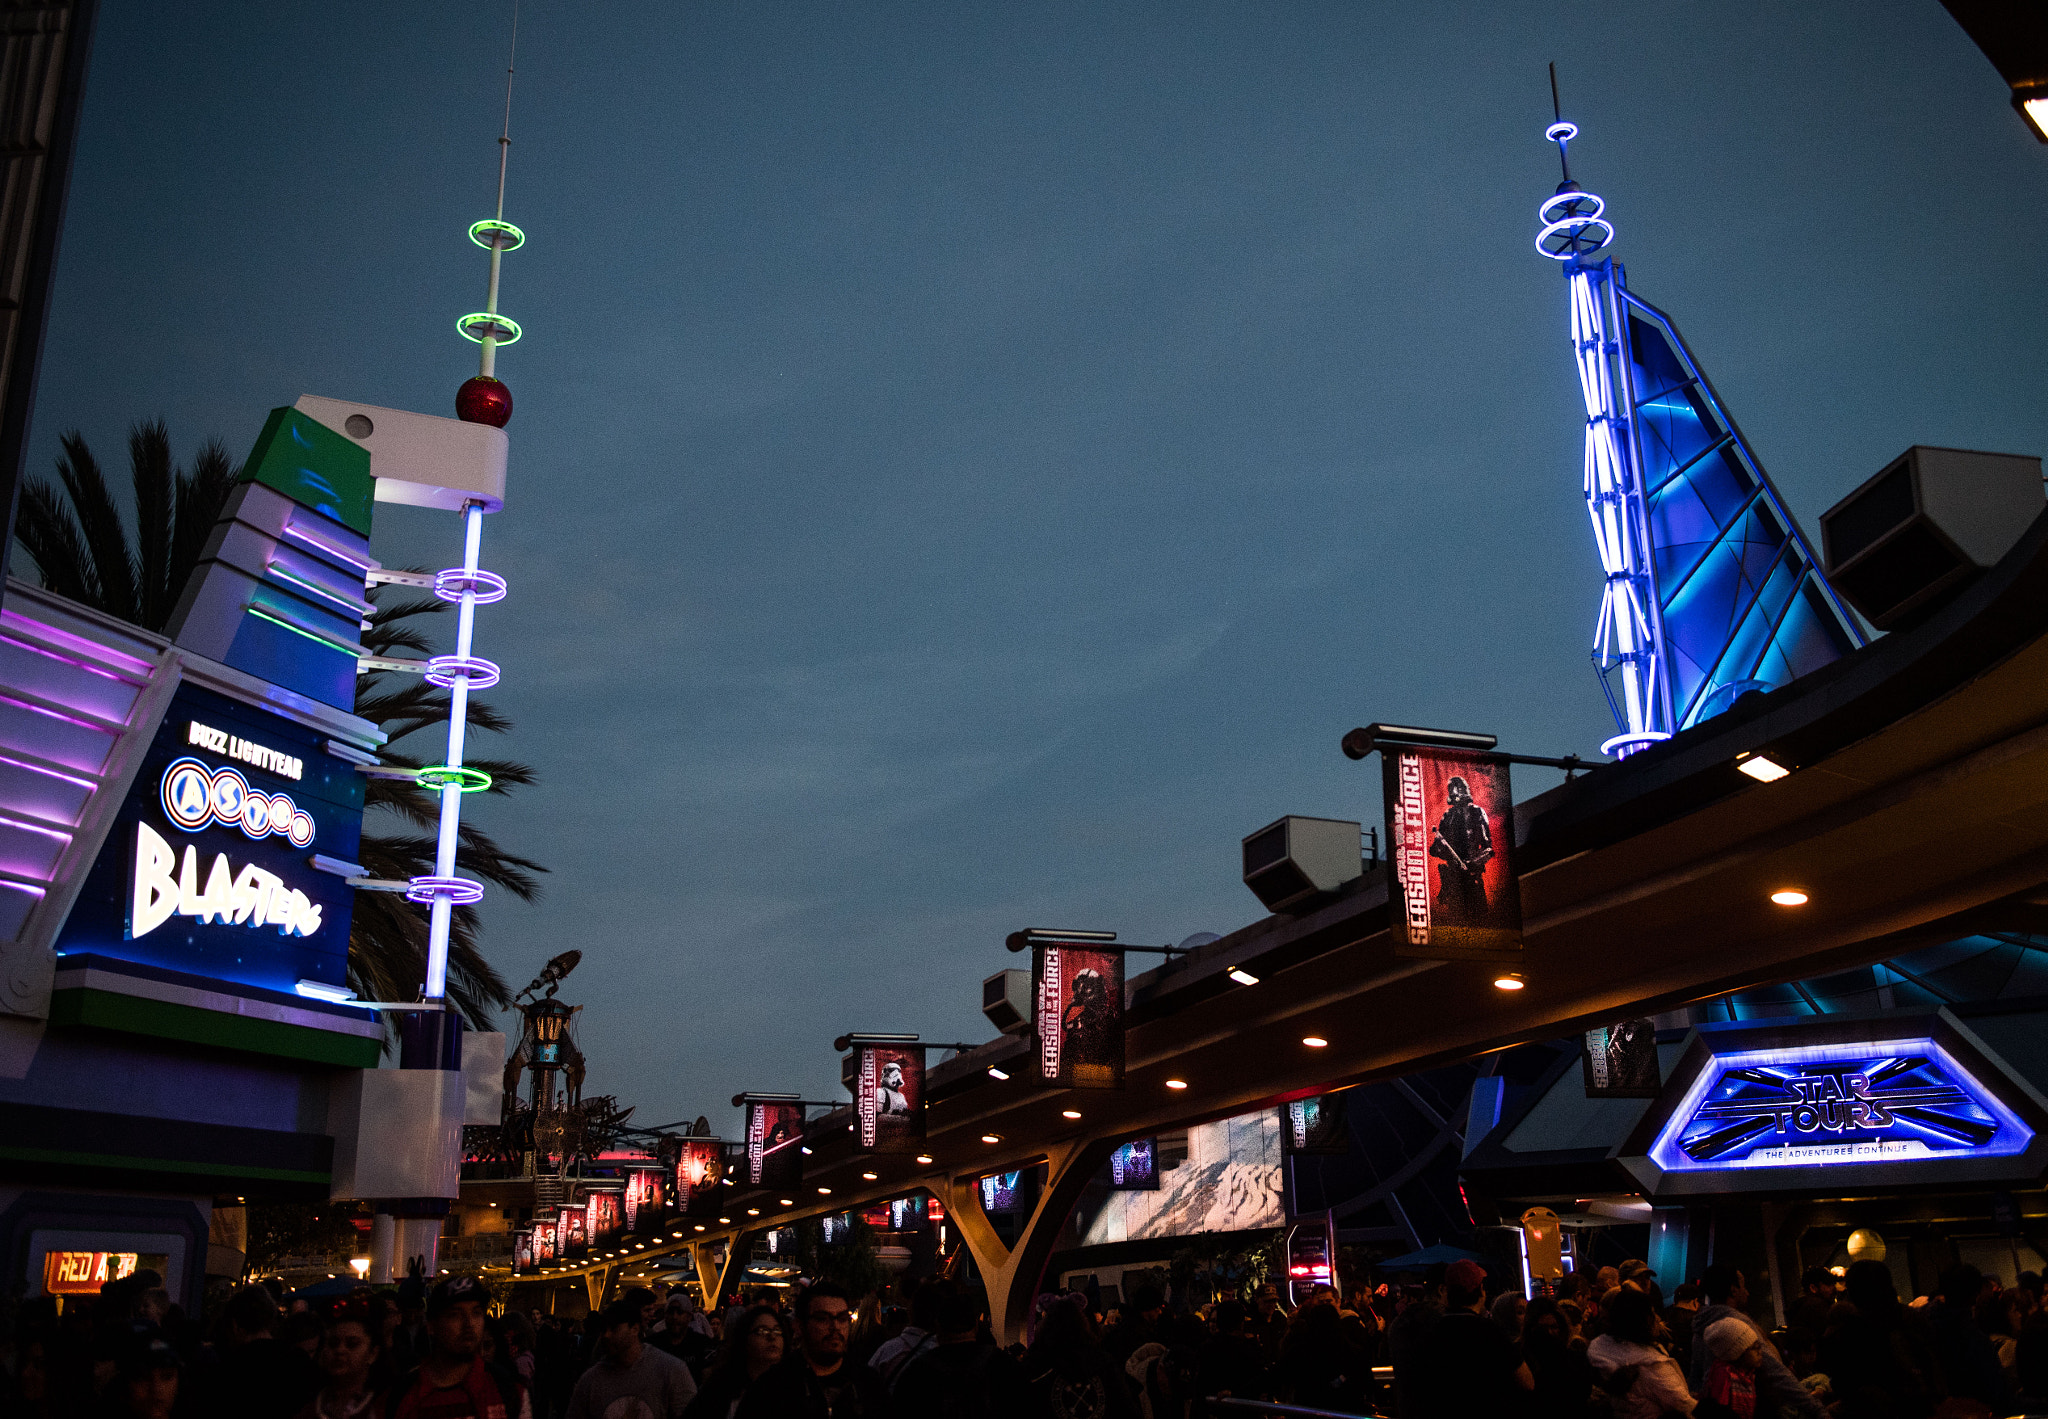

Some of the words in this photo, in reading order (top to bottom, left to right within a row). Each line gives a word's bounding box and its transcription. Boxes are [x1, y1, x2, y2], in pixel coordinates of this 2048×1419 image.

[189, 720, 228, 754] BUZZ
[229, 735, 303, 781] LIGHTYEAR
[1402, 753, 1424, 828] FORCE
[132, 820, 323, 939] BLASTERS
[1406, 849, 1429, 945] SEASON
[1046, 946, 1058, 997] FORCE
[1045, 1012, 1057, 1079] SEASON
[1783, 1074, 1870, 1104] STAR
[864, 1097, 874, 1147] SEASON
[1773, 1100, 1895, 1134] TOURS
[1765, 1151, 1783, 1159] THE
[1789, 1147, 1853, 1158] ADVENTURES
[1857, 1144, 1908, 1155] CONTINUE
[57, 1252, 94, 1282] RED
